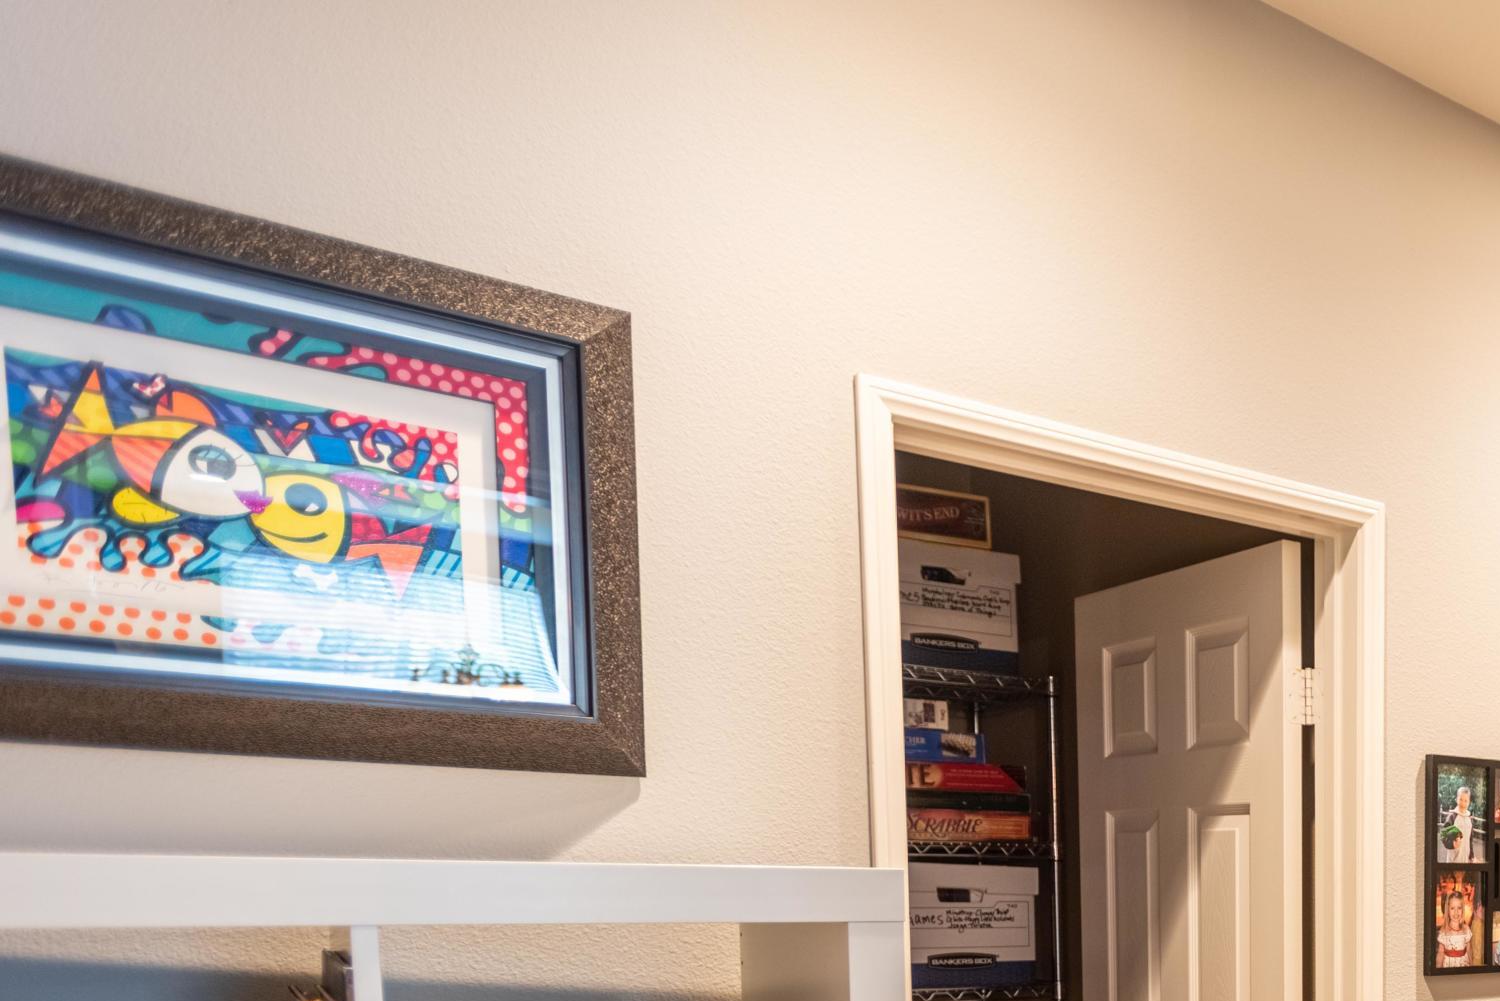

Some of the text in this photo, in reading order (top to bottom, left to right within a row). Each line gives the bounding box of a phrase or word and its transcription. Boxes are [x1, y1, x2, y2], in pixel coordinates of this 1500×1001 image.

[914, 637, 976, 649] BANKERS BOX
[931, 957, 993, 966] BANKERS BOX
